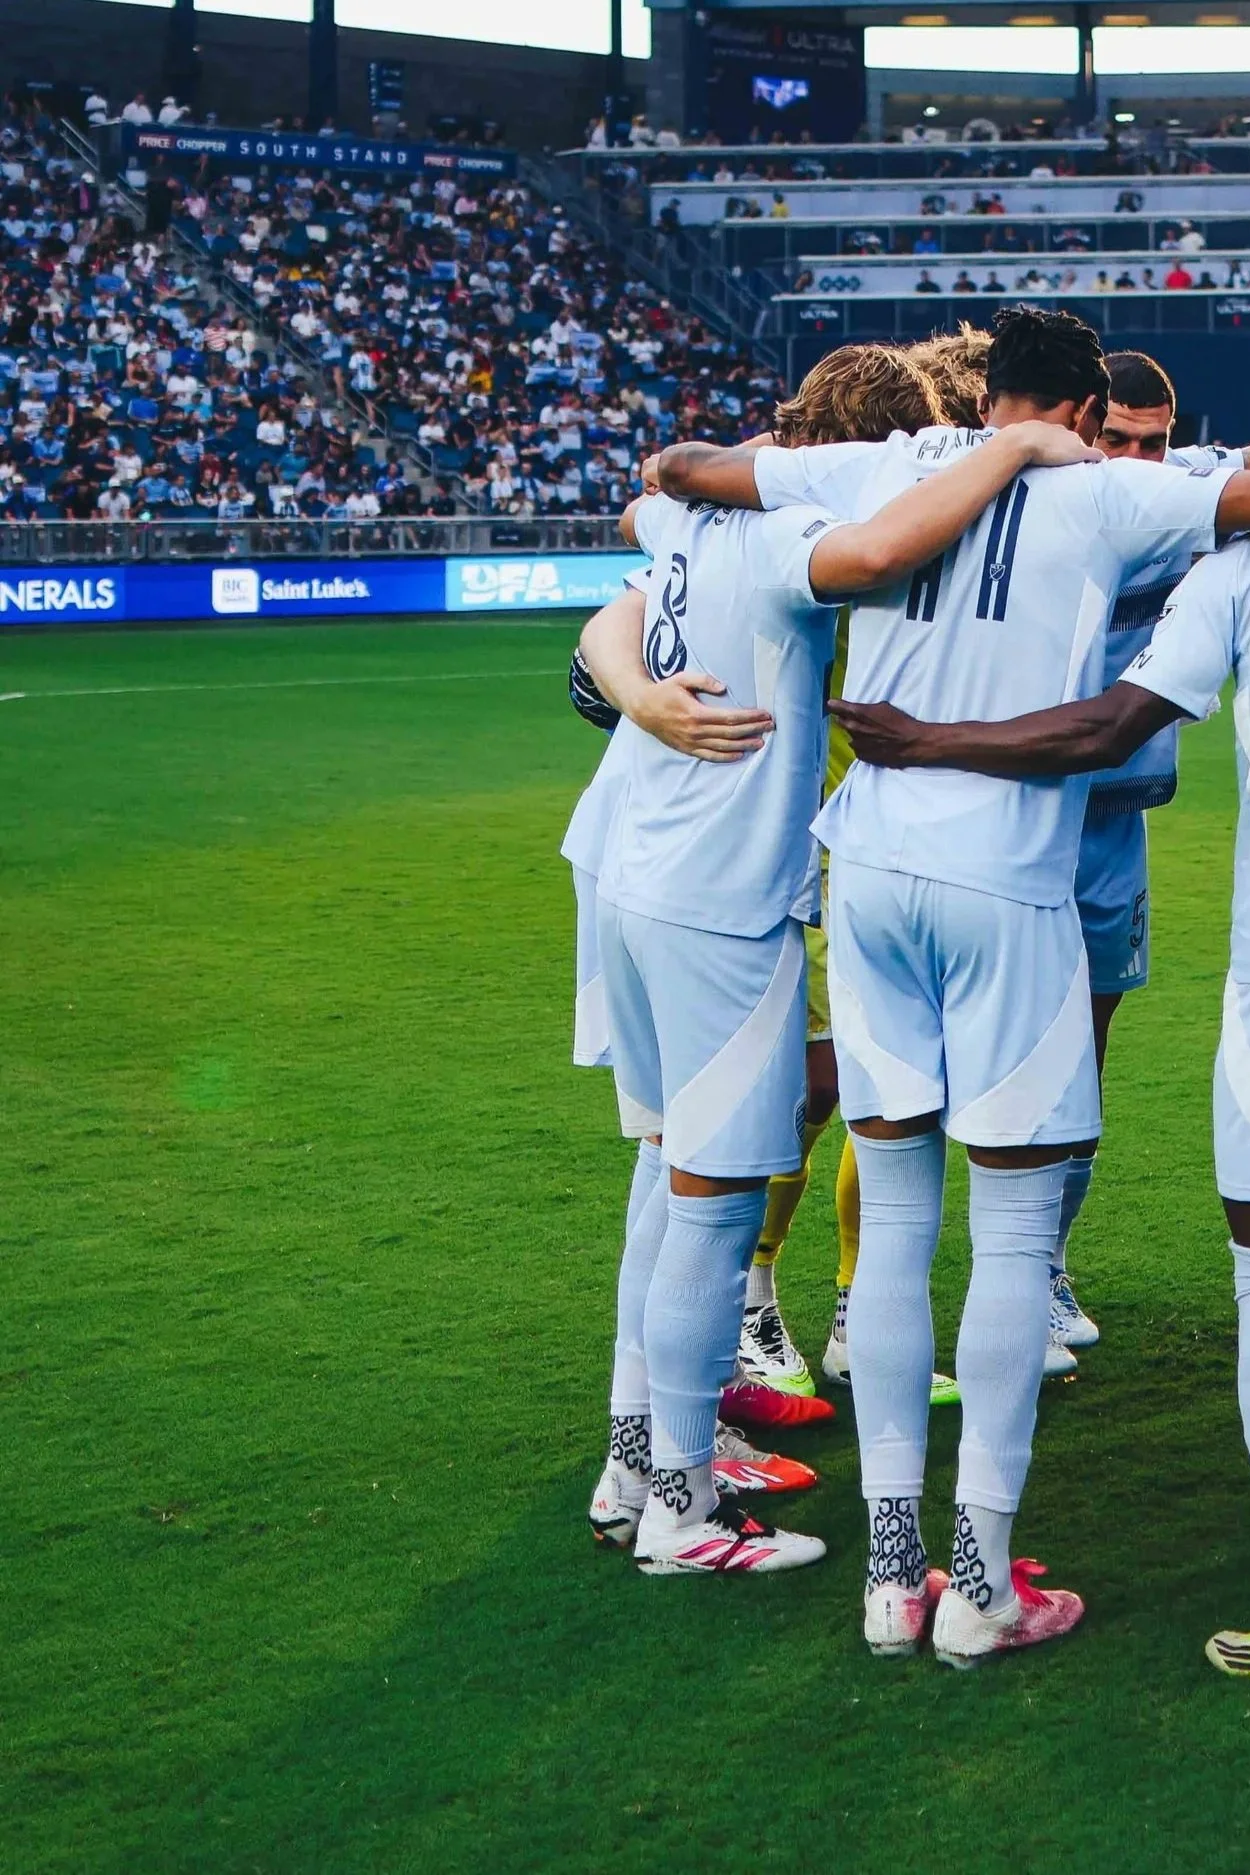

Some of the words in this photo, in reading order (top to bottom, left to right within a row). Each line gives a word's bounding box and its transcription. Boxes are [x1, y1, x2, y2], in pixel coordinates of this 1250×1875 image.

[138, 136, 170, 149] PRICE
[240, 142, 317, 158] SOUTH
[334, 147, 407, 165] STAND
[0, 578, 116, 611] NERALS
[262, 579, 309, 600] Saint
[461, 562, 564, 605] DFA
[646, 552, 688, 682] 8
[1130, 888, 1147, 948] 5
